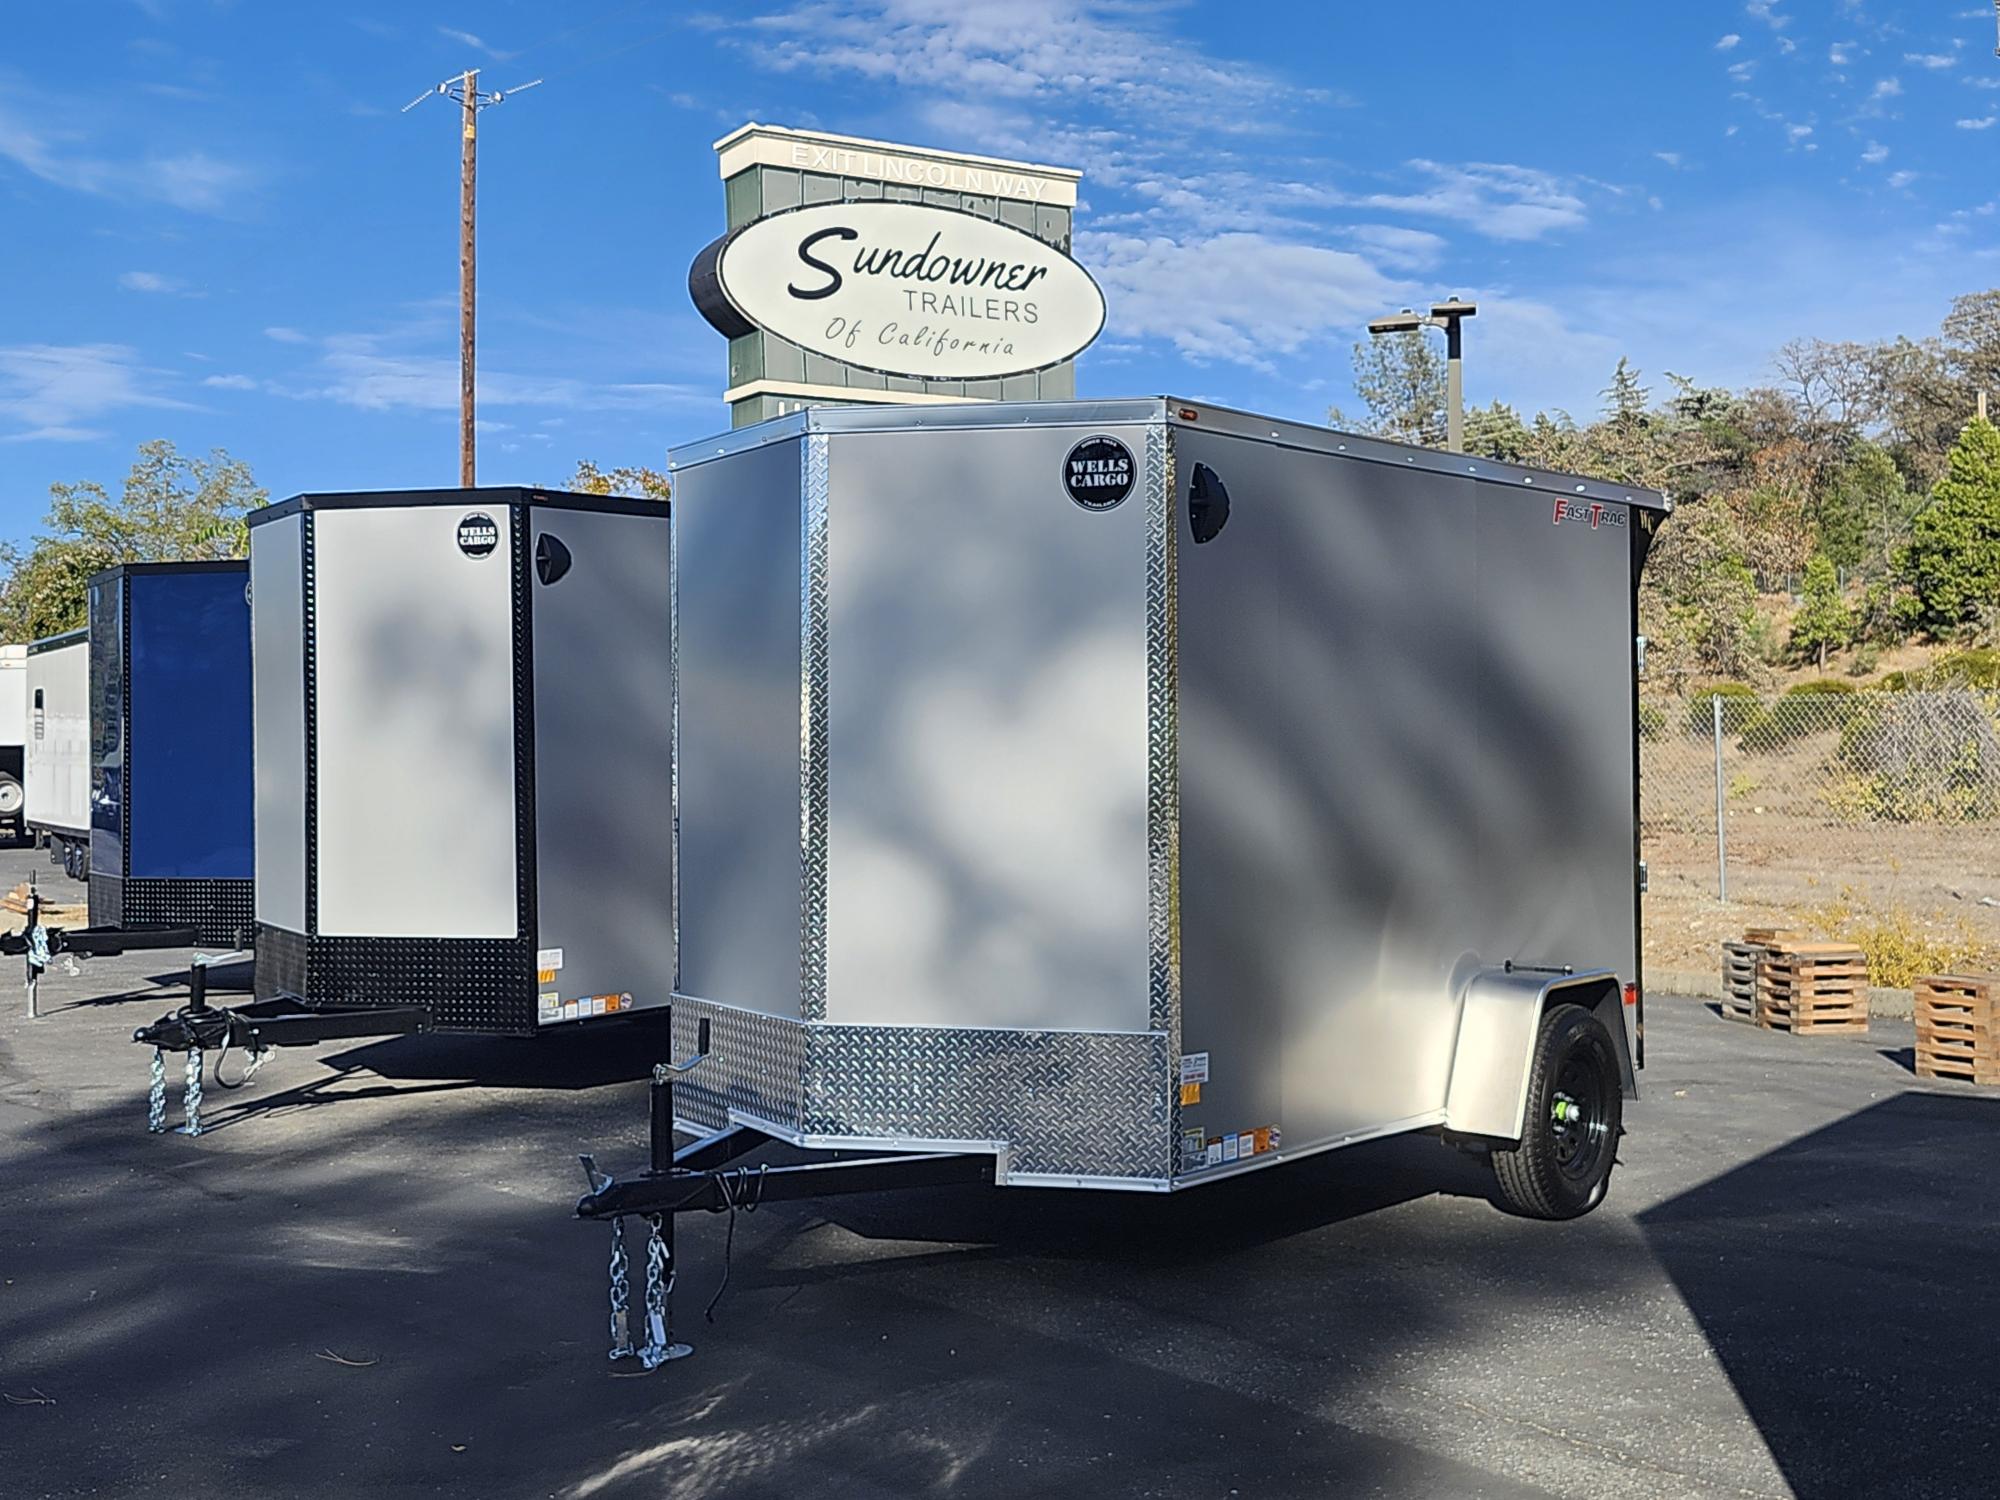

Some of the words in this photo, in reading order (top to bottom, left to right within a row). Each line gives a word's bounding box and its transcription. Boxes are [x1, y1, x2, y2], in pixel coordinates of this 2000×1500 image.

[791, 143, 857, 173] EXIT
[863, 154, 983, 191] LINCOLN
[991, 174, 1048, 200] WAY
[787, 226, 1048, 300] Sundowner
[903, 289, 1039, 324] TRAILERS
[825, 316, 862, 349] Of
[878, 321, 1015, 357] California
[1070, 458, 1129, 474] WELLS
[1070, 473, 1129, 488] CARGO
